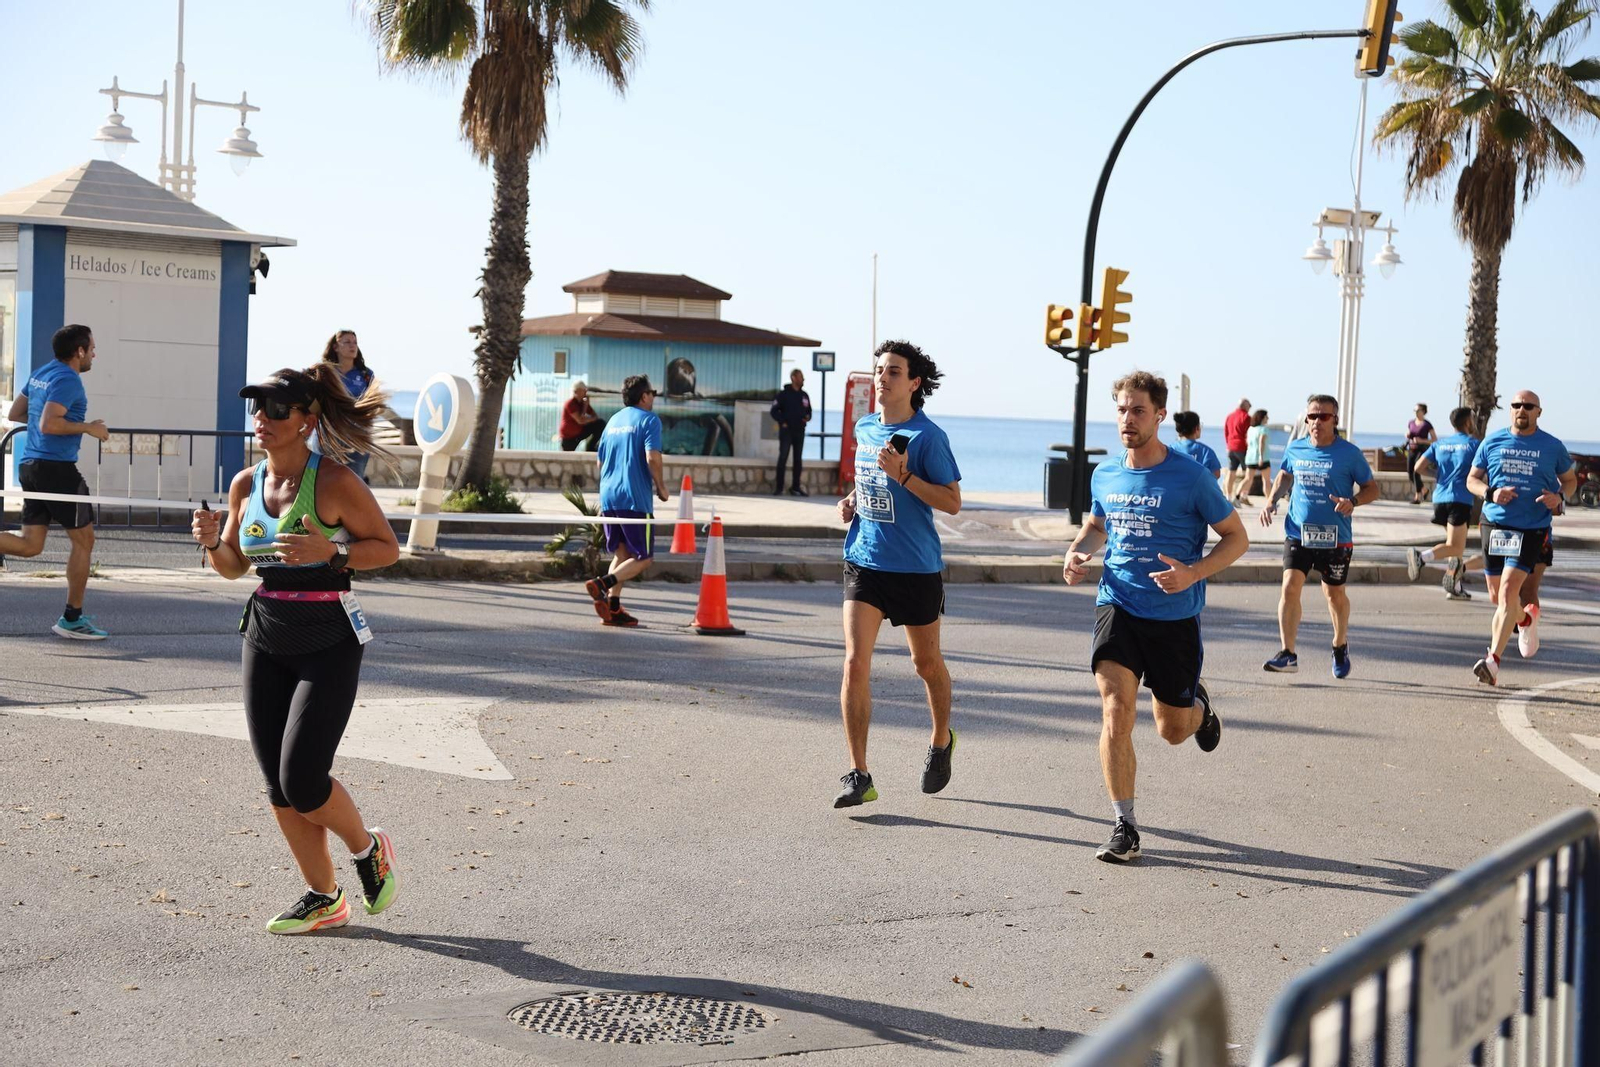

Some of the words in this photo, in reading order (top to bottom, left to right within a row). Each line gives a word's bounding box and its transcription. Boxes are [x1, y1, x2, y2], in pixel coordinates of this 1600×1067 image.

[70, 254, 127, 274] Helados
[131, 259, 137, 275] /
[141, 260, 161, 277] Ice
[165, 262, 216, 281] Creams
[1500, 448, 1540, 458] mayoral
[1295, 460, 1333, 469] mayoral
[1106, 493, 1162, 508] mayoral
[1306, 532, 1333, 540] 1762
